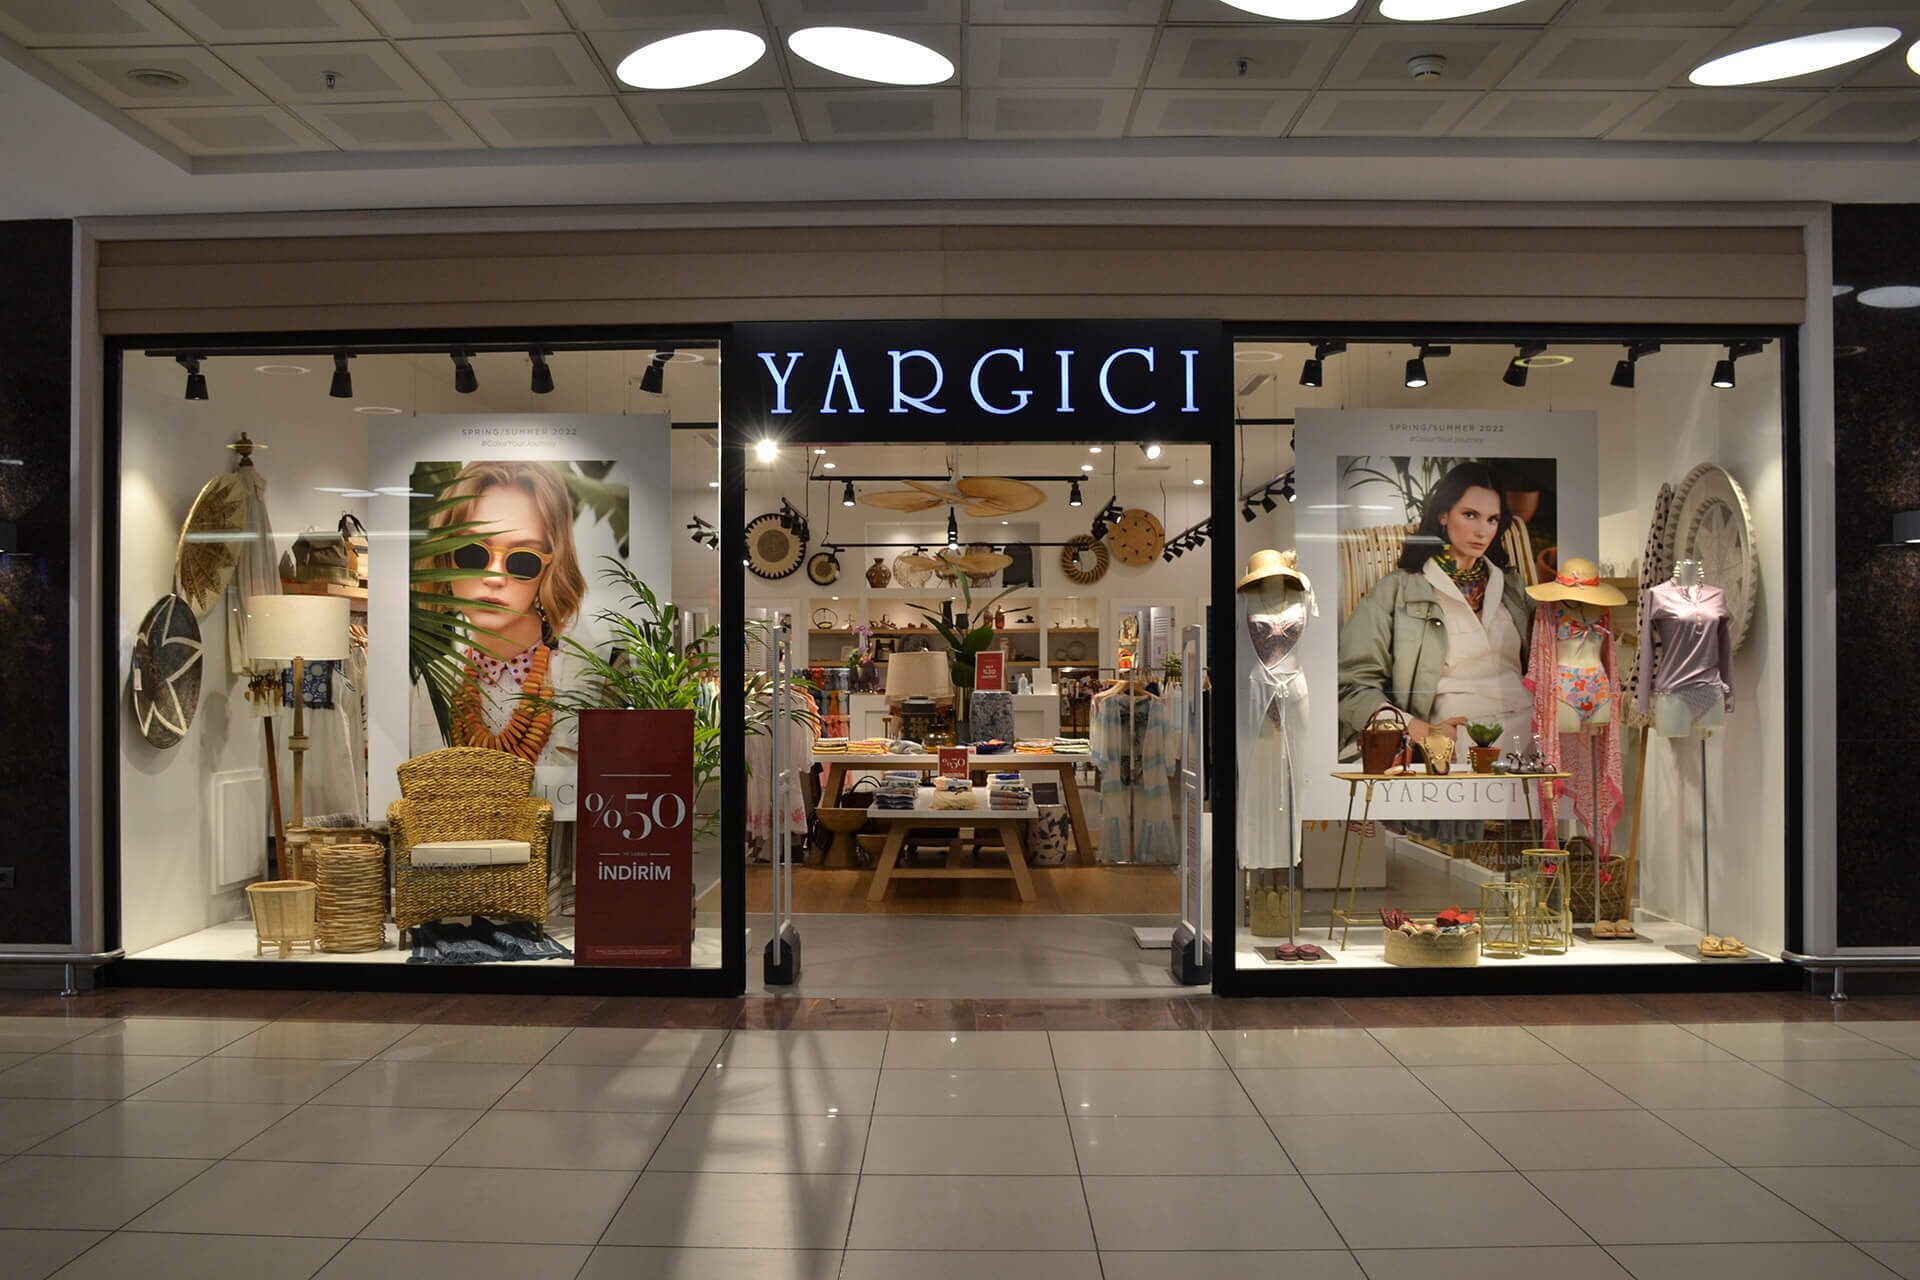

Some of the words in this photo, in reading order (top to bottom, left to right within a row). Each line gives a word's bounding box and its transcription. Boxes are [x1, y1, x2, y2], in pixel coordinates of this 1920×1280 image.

[757, 347, 1200, 415] YARGICI
[461, 427, 548, 437] SPRING/SUMMER
[552, 427, 577, 436] 2022
[1388, 423, 1475, 432] SPRING/SUMMER
[1479, 424, 1505, 433] 2022
[1380, 782, 1517, 803] YARGICI
[584, 792, 686, 841] %50
[598, 862, 671, 881] İNDİRİM
